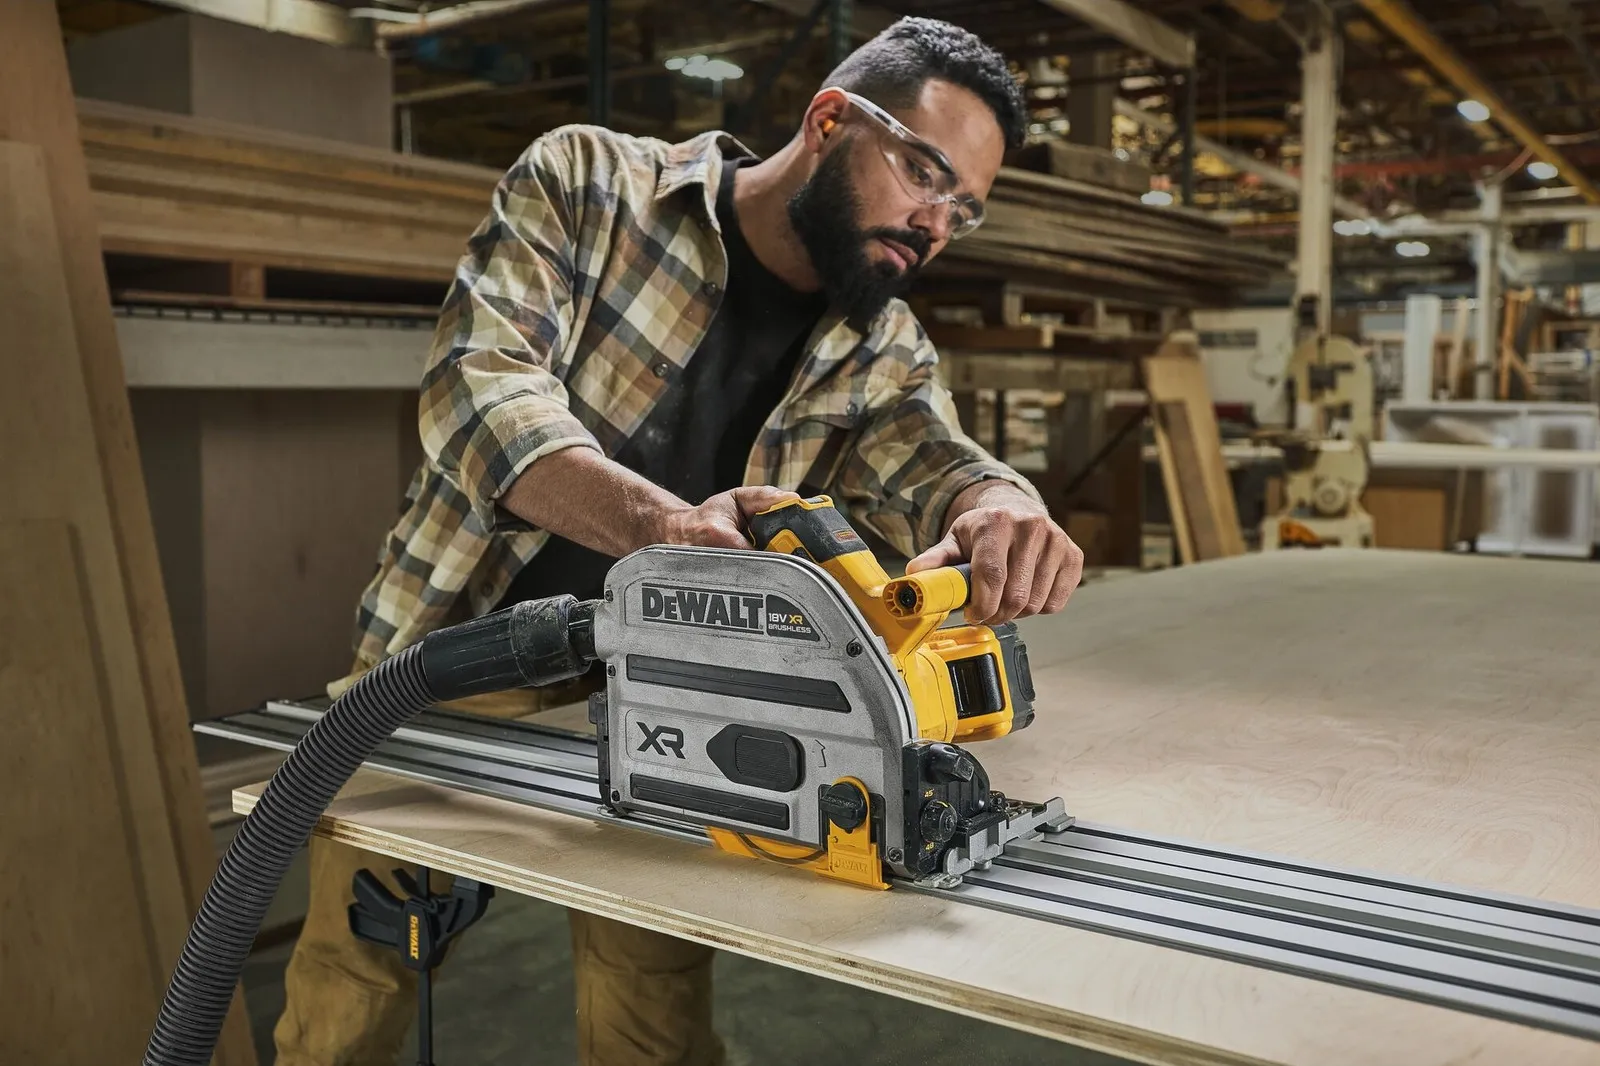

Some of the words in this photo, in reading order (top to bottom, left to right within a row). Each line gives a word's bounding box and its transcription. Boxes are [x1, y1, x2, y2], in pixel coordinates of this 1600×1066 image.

[768, 612, 787, 624] 18V
[788, 614, 803, 625] XR
[768, 623, 811, 634] BRUSHLESS
[636, 721, 686, 759] XR
[834, 859, 868, 872] DWALT
